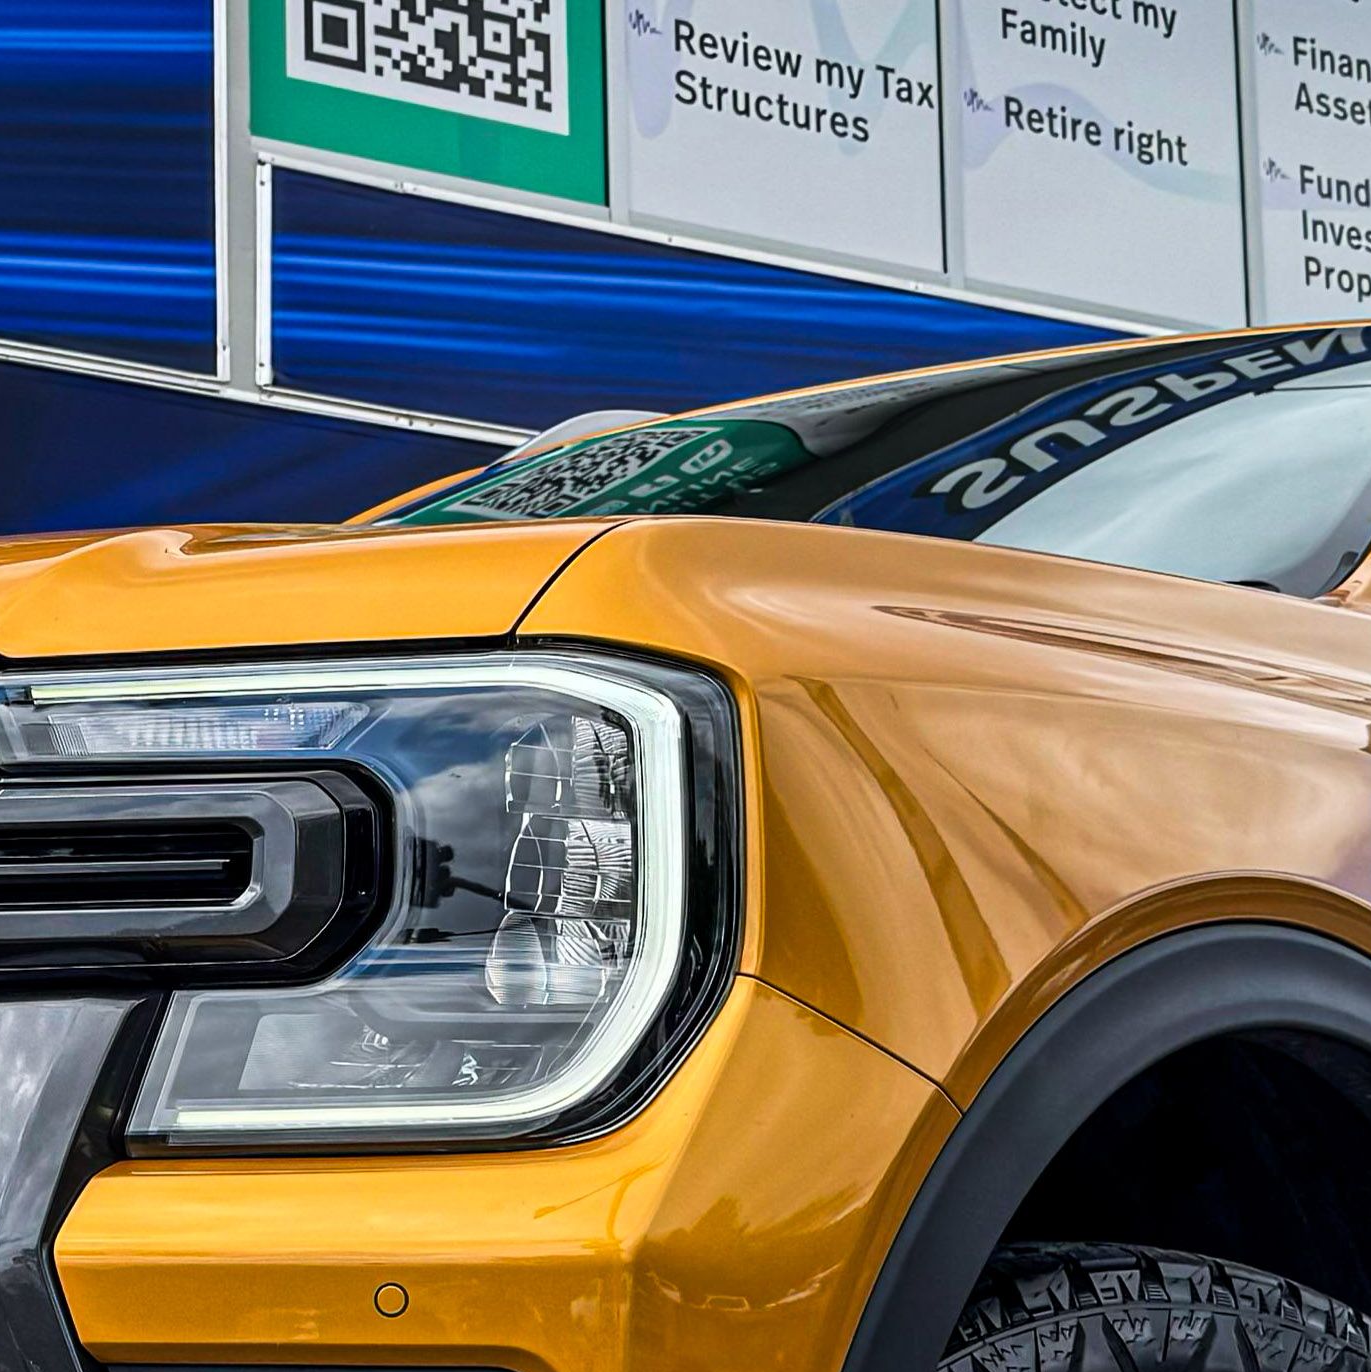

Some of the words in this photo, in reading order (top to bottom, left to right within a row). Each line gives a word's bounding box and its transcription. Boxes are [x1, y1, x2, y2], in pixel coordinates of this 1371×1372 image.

[1000, 7, 1106, 68] Family
[1132, 1, 1179, 39] my
[674, 19, 802, 78] Review
[815, 57, 865, 100] my
[876, 64, 935, 109] Tax
[674, 69, 870, 143] Structures
[1003, 95, 1102, 147] Retire
[1113, 120, 1189, 167] right
[1299, 164, 1371, 208] Fund
